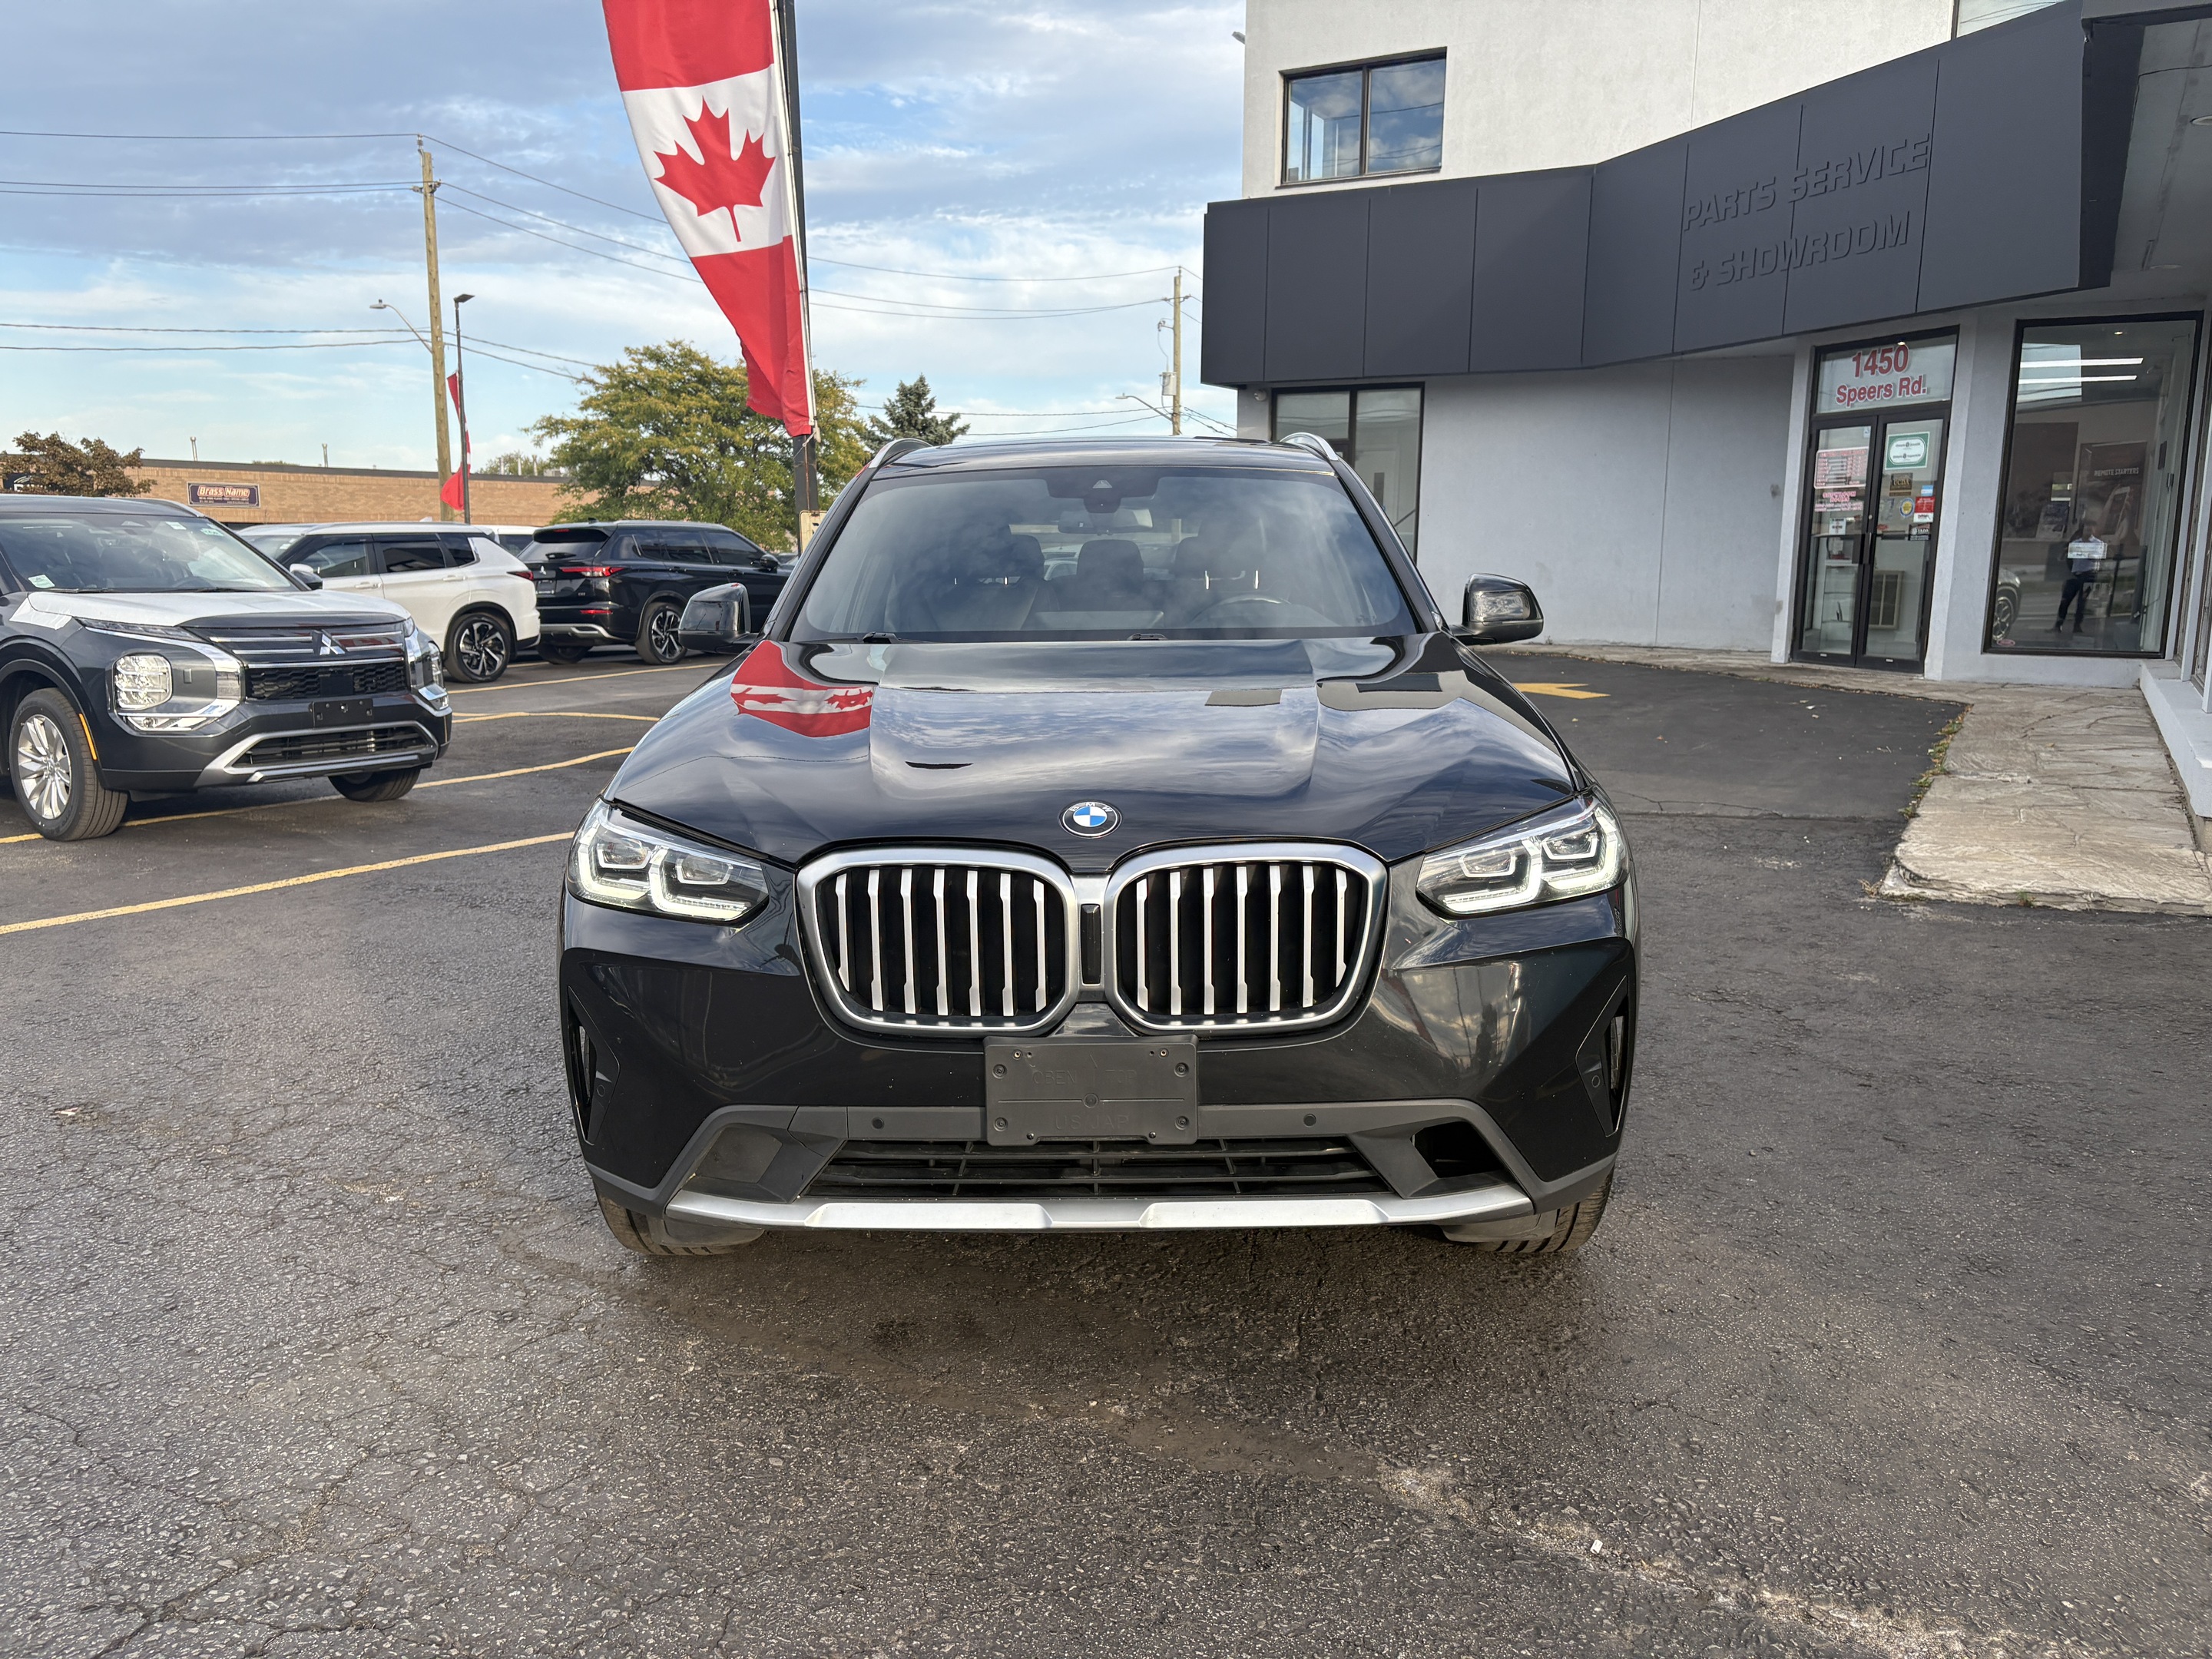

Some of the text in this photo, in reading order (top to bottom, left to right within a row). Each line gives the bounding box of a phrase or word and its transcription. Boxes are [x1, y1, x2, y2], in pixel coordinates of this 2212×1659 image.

[1684, 133, 1929, 231] PARTS SERVICE
[1717, 210, 1910, 286] SHOWROOM
[1852, 343, 1909, 378] 1450
[1835, 375, 1926, 408] Speers Rd.
[2114, 467, 2139, 475] STARTERS
[199, 486, 249, 497] Brass Name
[1068, 801, 1113, 813] BMW
